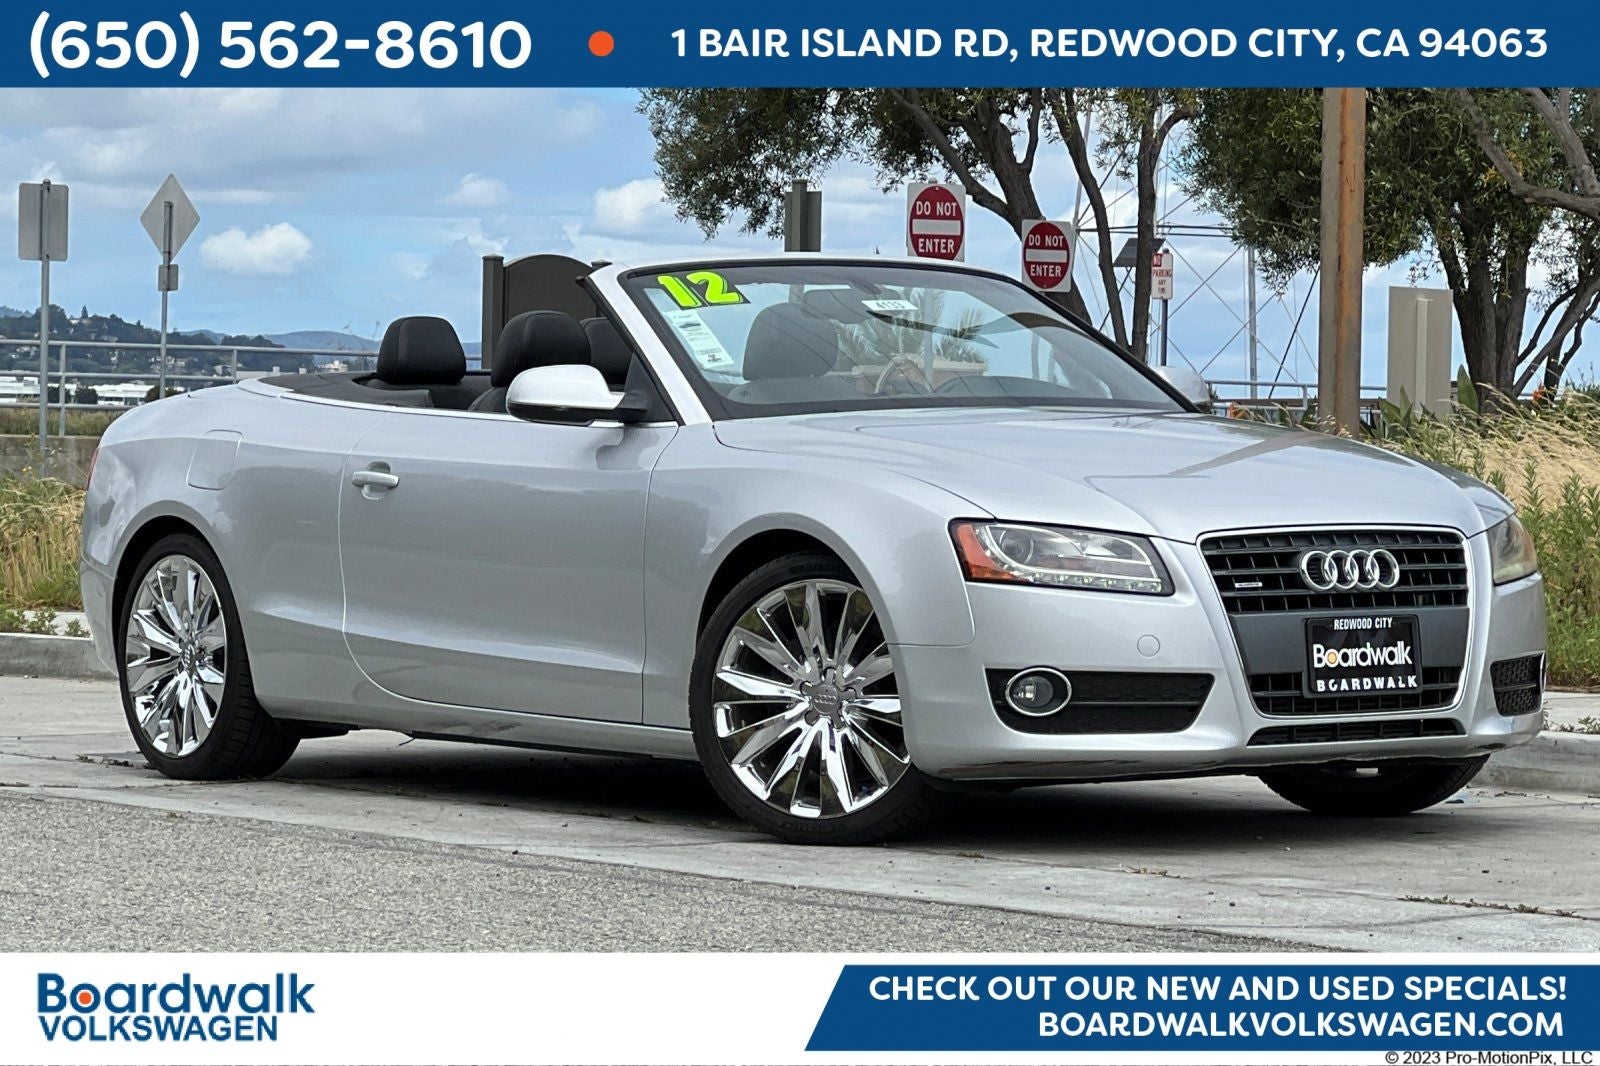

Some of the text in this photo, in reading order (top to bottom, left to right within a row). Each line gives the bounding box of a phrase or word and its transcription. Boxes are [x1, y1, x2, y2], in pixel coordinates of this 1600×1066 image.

[916, 201, 957, 216] DO NOT
[918, 238, 955, 254] ENTER
[1028, 235, 1064, 247] DO NOT
[1030, 264, 1062, 277] ENTER
[657, 271, 744, 307] 12
[1333, 617, 1393, 631] REDWOOD CITY
[1312, 640, 1413, 669] Boardwalk
[1316, 675, 1418, 692] BOARDWALK
